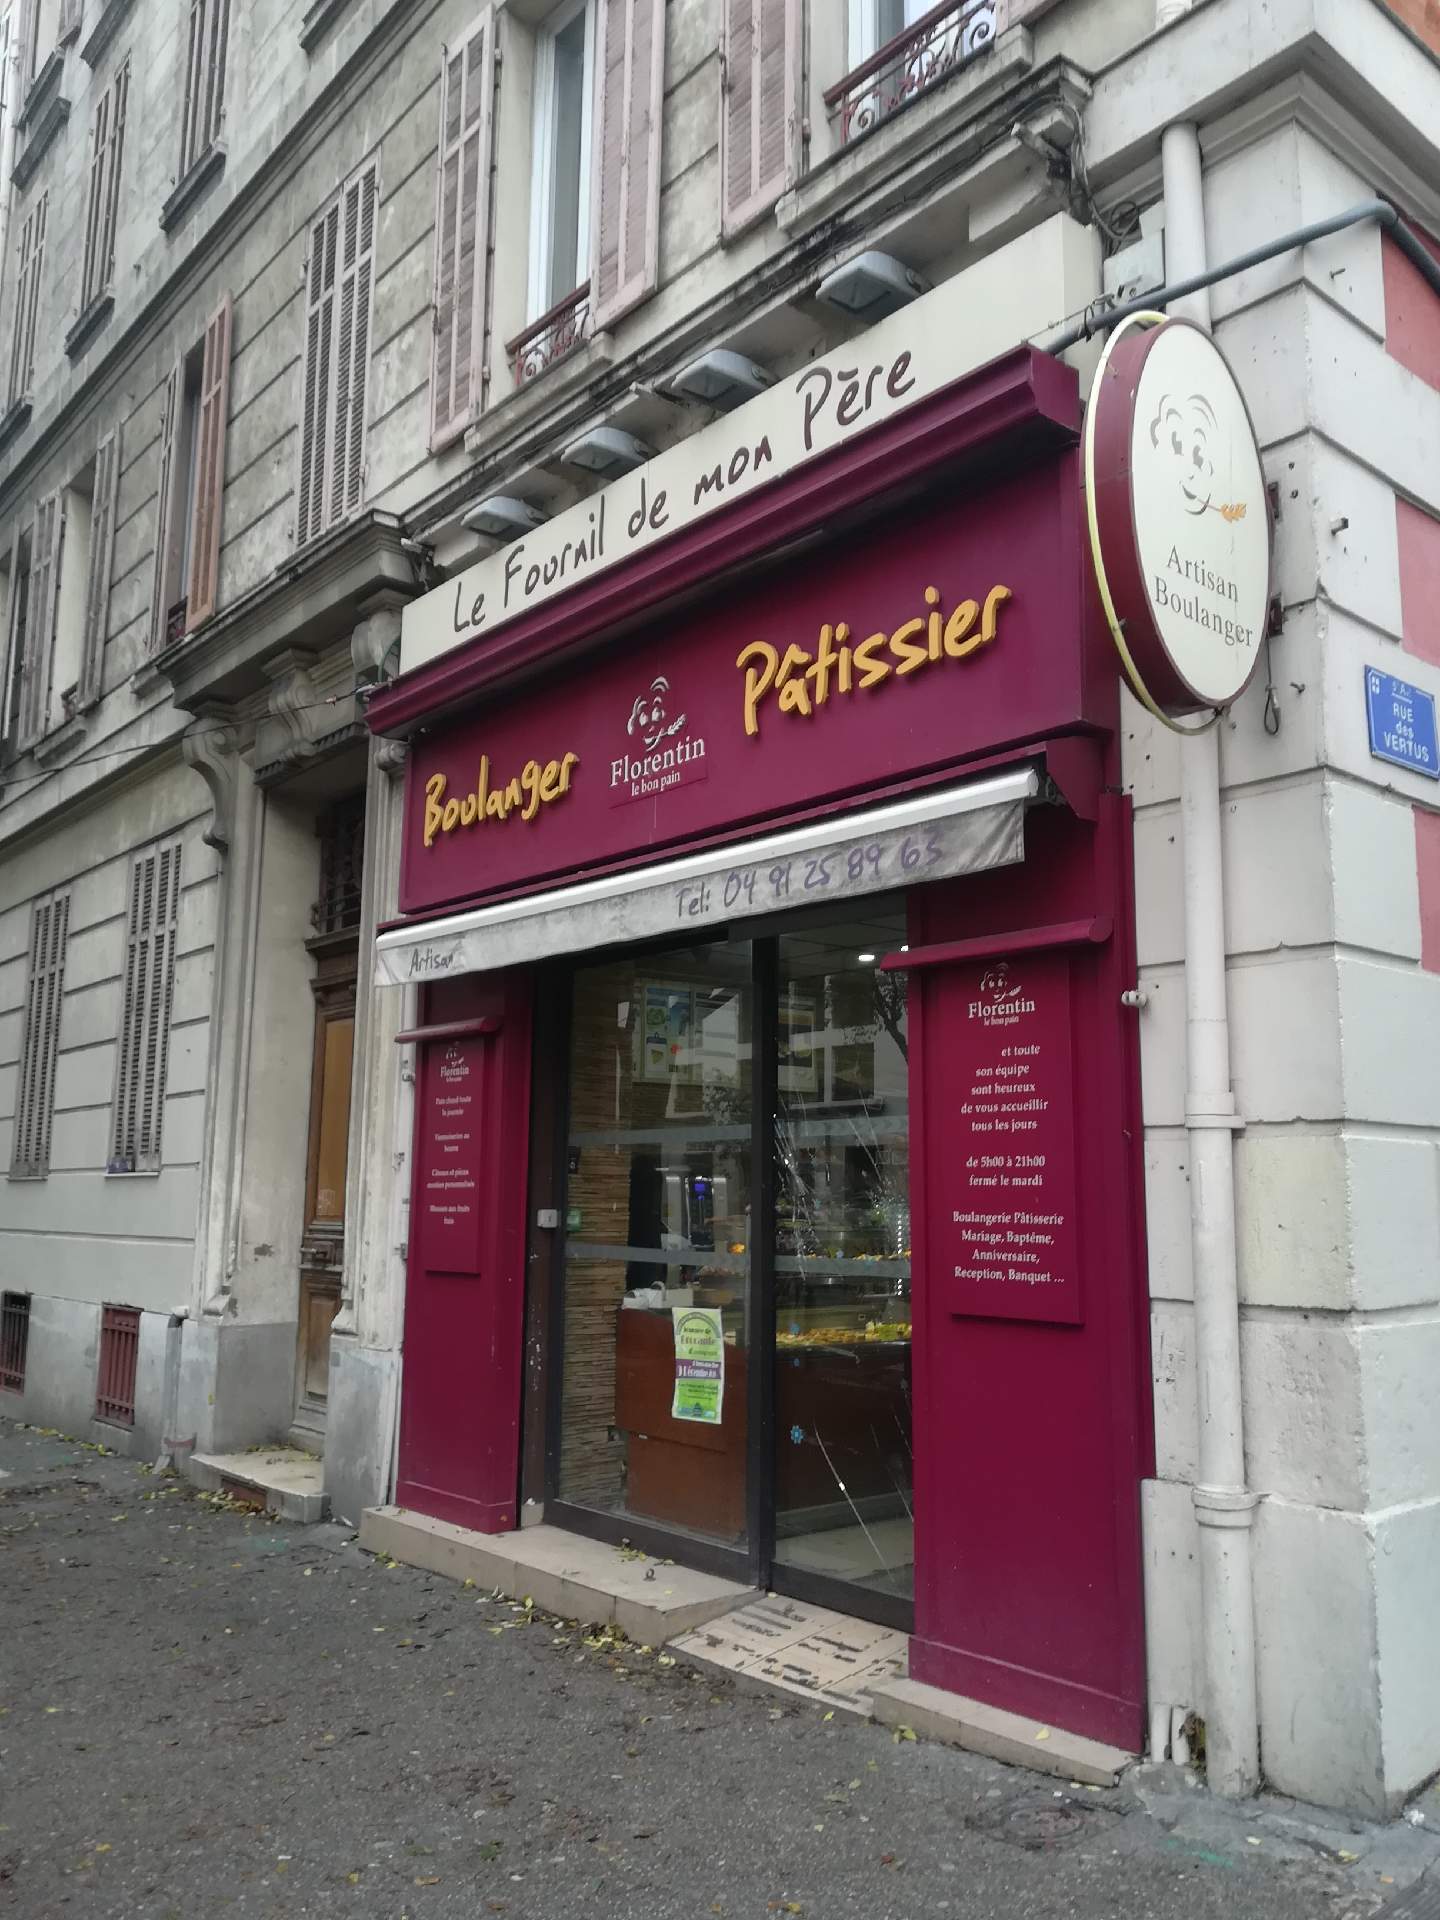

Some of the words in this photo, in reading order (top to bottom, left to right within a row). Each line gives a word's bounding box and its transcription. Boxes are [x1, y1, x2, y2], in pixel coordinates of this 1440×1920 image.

[453, 580, 485, 633] Le
[503, 498, 604, 609] Fournil
[627, 477, 670, 539] de
[693, 436, 772, 505] mon
[1166, 545, 1239, 604] Artisan
[1154, 575, 1254, 648] Boulanger
[735, 585, 1012, 736] Pâtissier
[1393, 702, 1414, 722] RUE
[1396, 721, 1415, 740] des
[1384, 731, 1430, 762] VERTUS
[609, 736, 706, 787] Florentin
[631, 782, 640, 796] le
[641, 779, 659, 793] bon
[660, 770, 681, 792] pain
[423, 751, 580, 848] Boulanger
[724, 871, 757, 908] 04
[768, 861, 792, 897] 91
[803, 851, 842, 889] 25
[847, 842, 882, 880] 89
[968, 998, 1035, 1019] Florentin
[1001, 1046, 1012, 1057] et
[1014, 1044, 1041, 1057] toute
[976, 1067, 993, 1077] son
[995, 1063, 1030, 1079] équipe
[971, 1084, 992, 1096] sont
[994, 1082, 1036, 1095] heureux
[960, 1102, 973, 1115] de
[975, 1103, 999, 1113] vous
[1000, 1098, 1049, 1113] accueillir
[971, 1121, 993, 1132] tous
[995, 1118, 1009, 1130] les
[1011, 1118, 1038, 1133] jours
[966, 1156, 979, 1168] de
[980, 1155, 1005, 1168] 5h00
[1006, 1155, 1013, 1167] à
[1015, 1155, 1046, 1168] 21h00
[969, 1174, 998, 1186] fermé
[1000, 1174, 1010, 1186] le
[1012, 1174, 1043, 1186] mardi
[953, 1210, 1012, 1226] Boulangerie
[1014, 1211, 1065, 1225] Pâtisserie
[961, 1229, 1005, 1245] Mariage,
[1006, 1230, 1055, 1246] Baptême,
[972, 1248, 1041, 1264] Anniversaire,
[954, 1266, 1006, 1282] Reception,
[1008, 1268, 1052, 1285] Banquet
